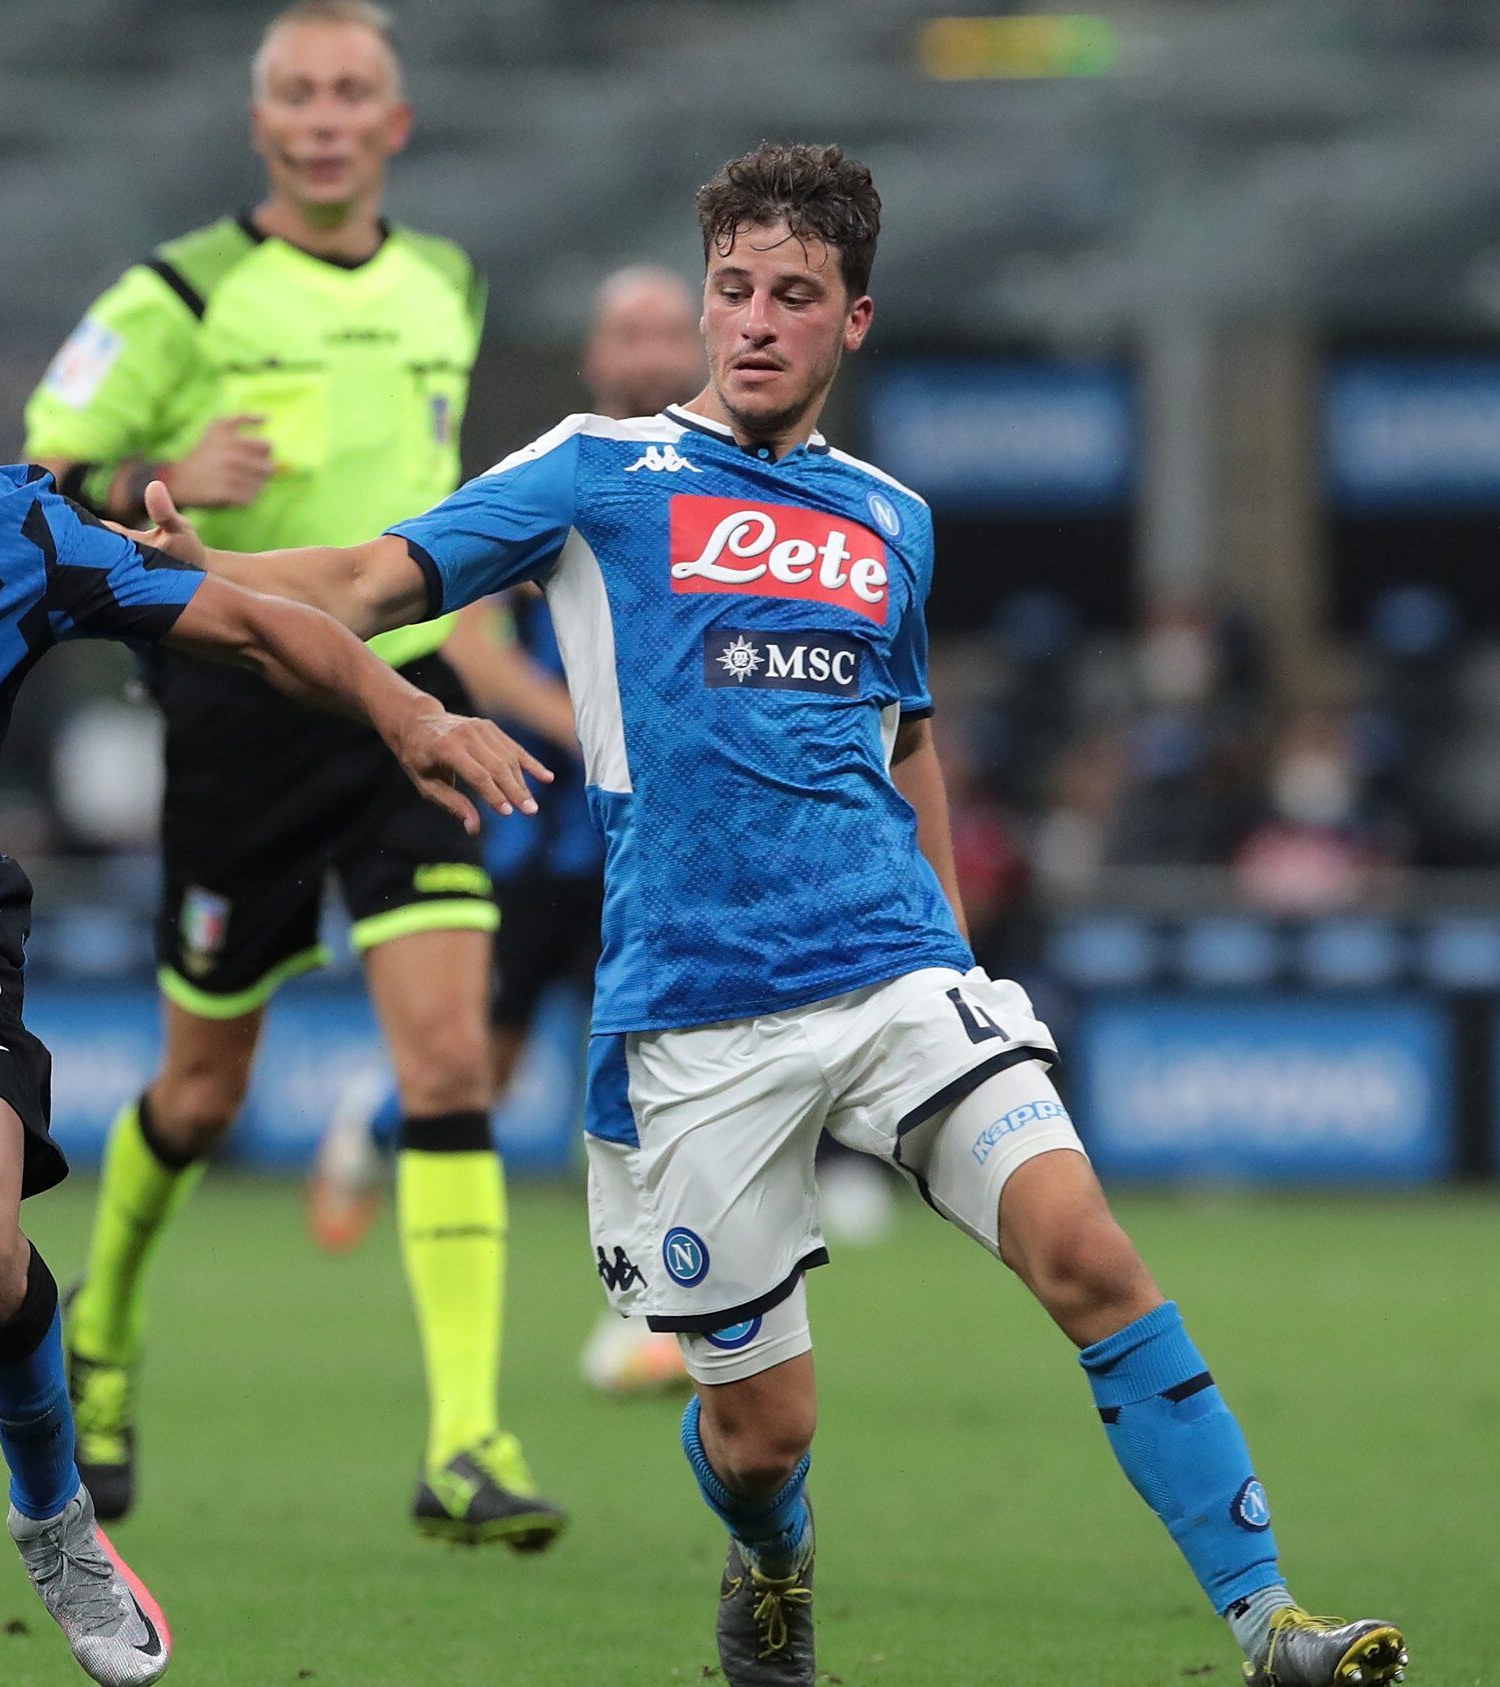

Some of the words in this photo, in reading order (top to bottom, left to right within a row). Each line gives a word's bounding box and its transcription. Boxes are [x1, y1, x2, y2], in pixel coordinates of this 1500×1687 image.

[671, 510, 888, 603] Lete
[765, 643, 857, 686] MSC
[945, 987, 1011, 1045] 4
[671, 1242, 695, 1271] N
